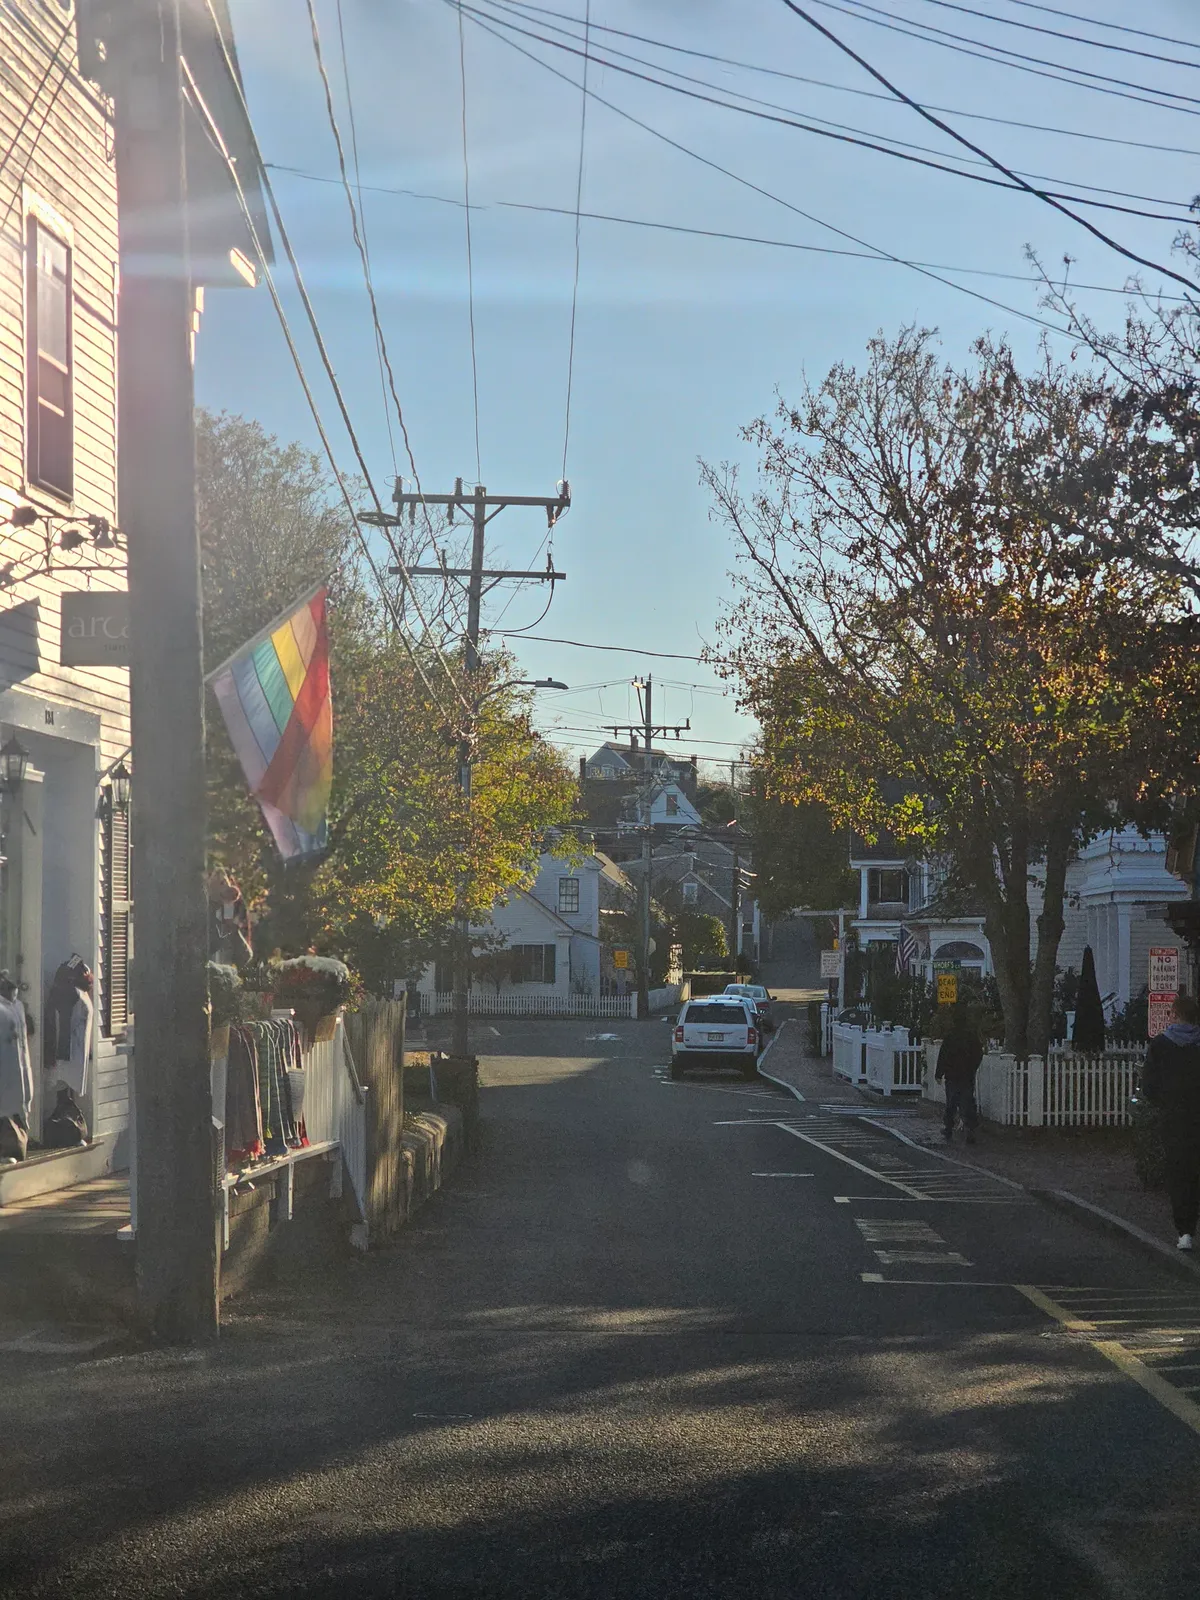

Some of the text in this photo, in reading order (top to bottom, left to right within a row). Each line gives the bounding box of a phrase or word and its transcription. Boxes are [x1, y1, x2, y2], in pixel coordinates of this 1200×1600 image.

[1153, 965, 1176, 973] PARKING
[938, 978, 956, 986] DEAD
[940, 990, 955, 999] END
